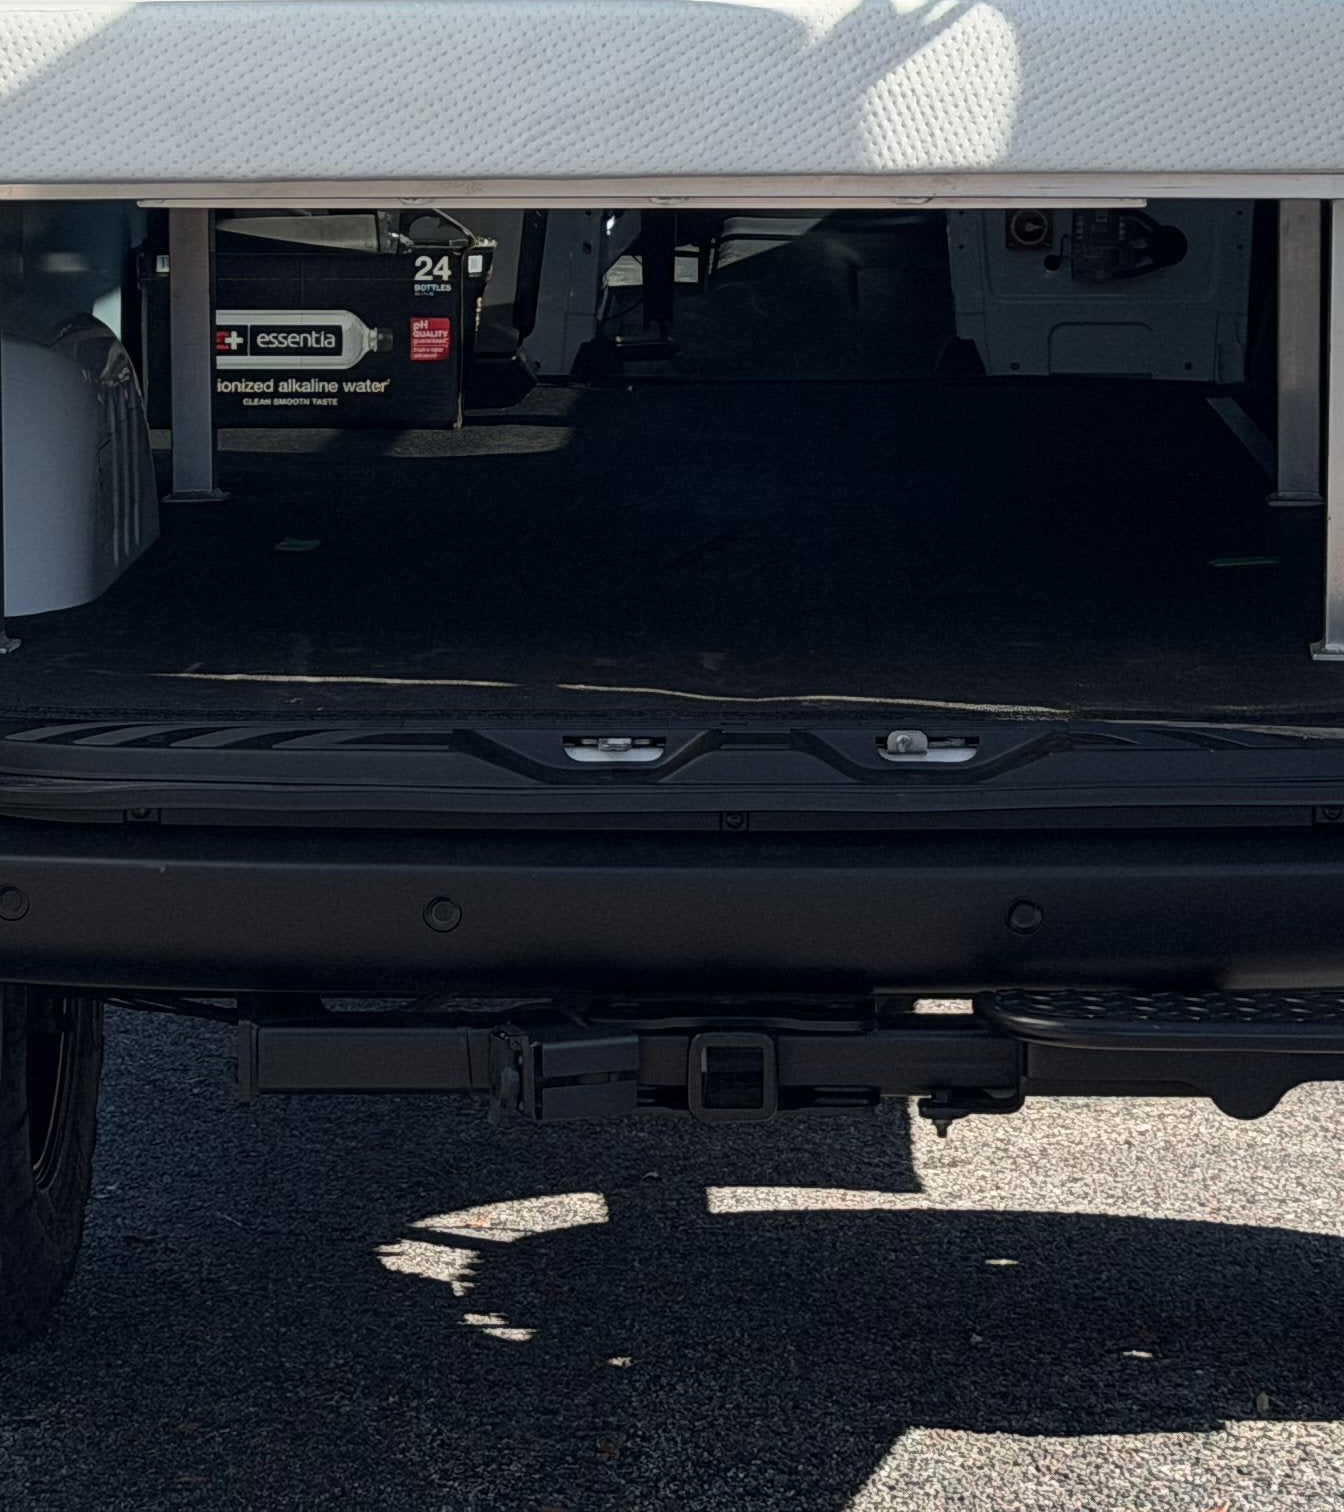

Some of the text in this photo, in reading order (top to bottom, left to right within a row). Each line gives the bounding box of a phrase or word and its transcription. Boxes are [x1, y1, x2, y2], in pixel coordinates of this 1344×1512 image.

[414, 255, 452, 280] 24
[414, 284, 452, 292] BOTTLES
[413, 320, 428, 330] pH
[256, 330, 336, 347] essentia
[413, 330, 448, 338] QUALITY
[216, 377, 388, 392] ionized alkaline water
[242, 397, 338, 406] CLEAN SMOOTH TASTE
